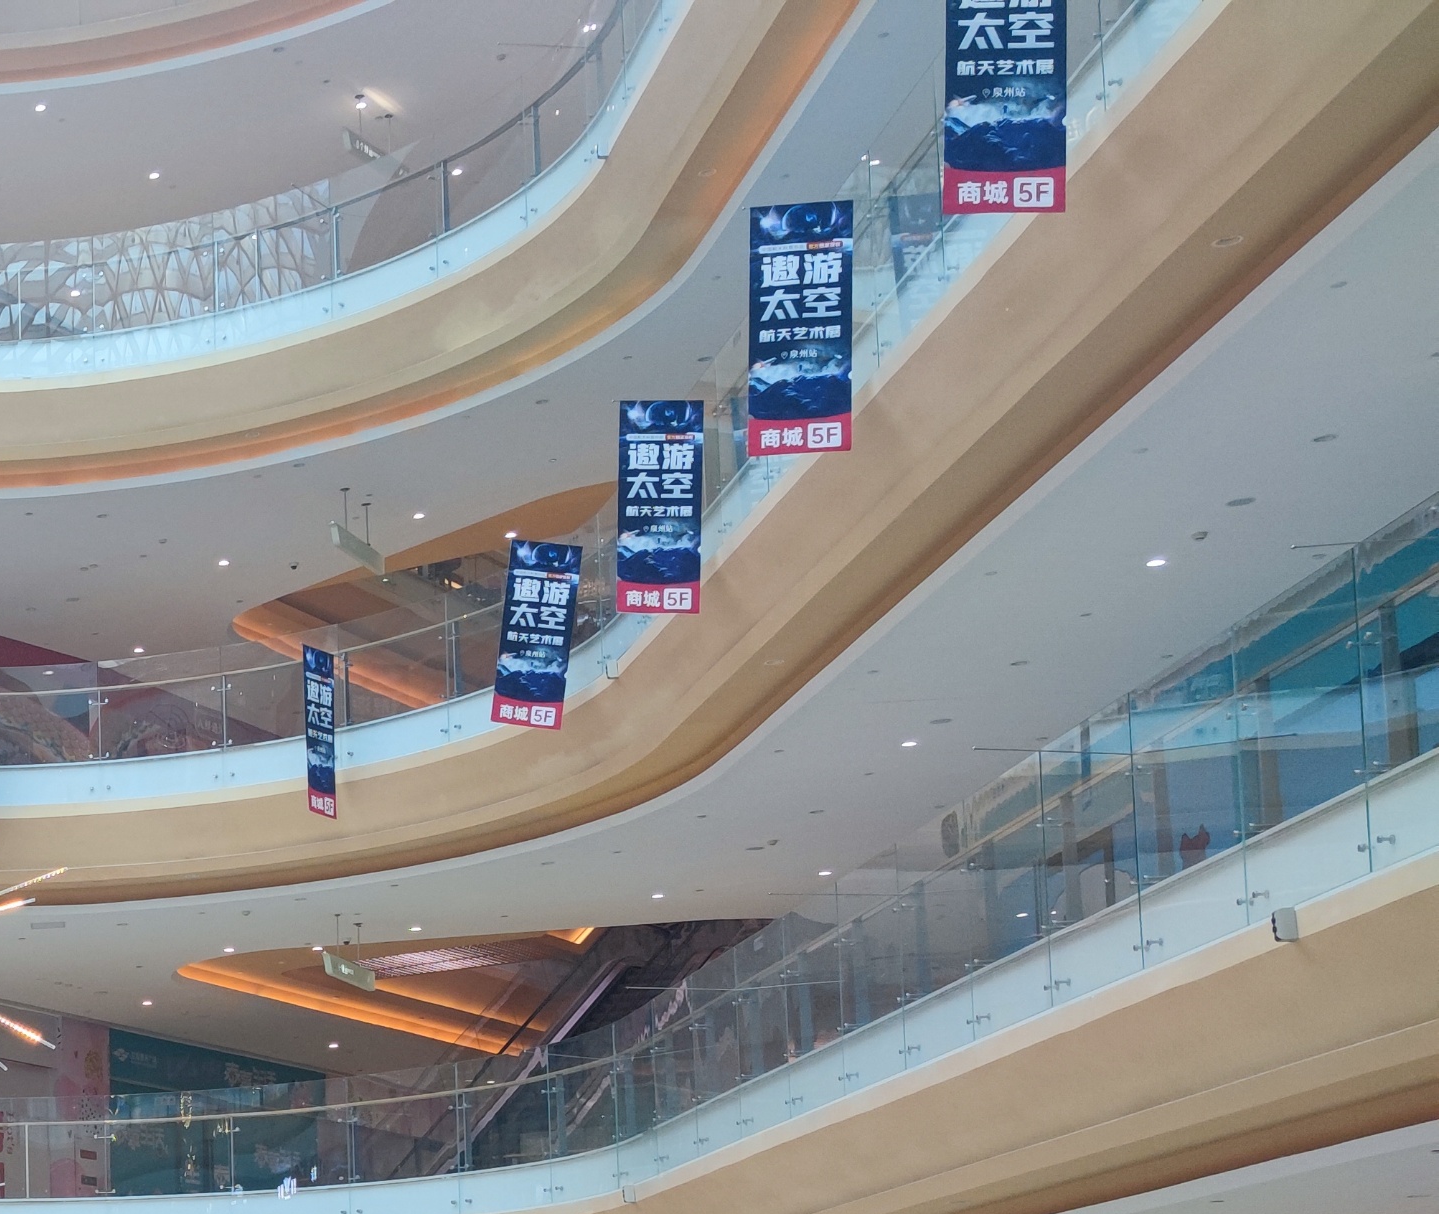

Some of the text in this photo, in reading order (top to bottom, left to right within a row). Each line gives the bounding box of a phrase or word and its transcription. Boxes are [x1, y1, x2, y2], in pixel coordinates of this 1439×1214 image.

[957, 12, 1055, 50] 太空
[956, 58, 1055, 77] 航天艺术展
[992, 87, 1026, 98] 泉州站
[957, 180, 1050, 205] 商城 5F
[760, 287, 841, 322] 太空
[789, 349, 818, 358] 泉州站
[811, 425, 840, 445] 5F
[627, 472, 693, 498] 太空
[666, 591, 690, 607] 5F
[509, 604, 567, 630] 太空
[533, 709, 554, 723] 5F
